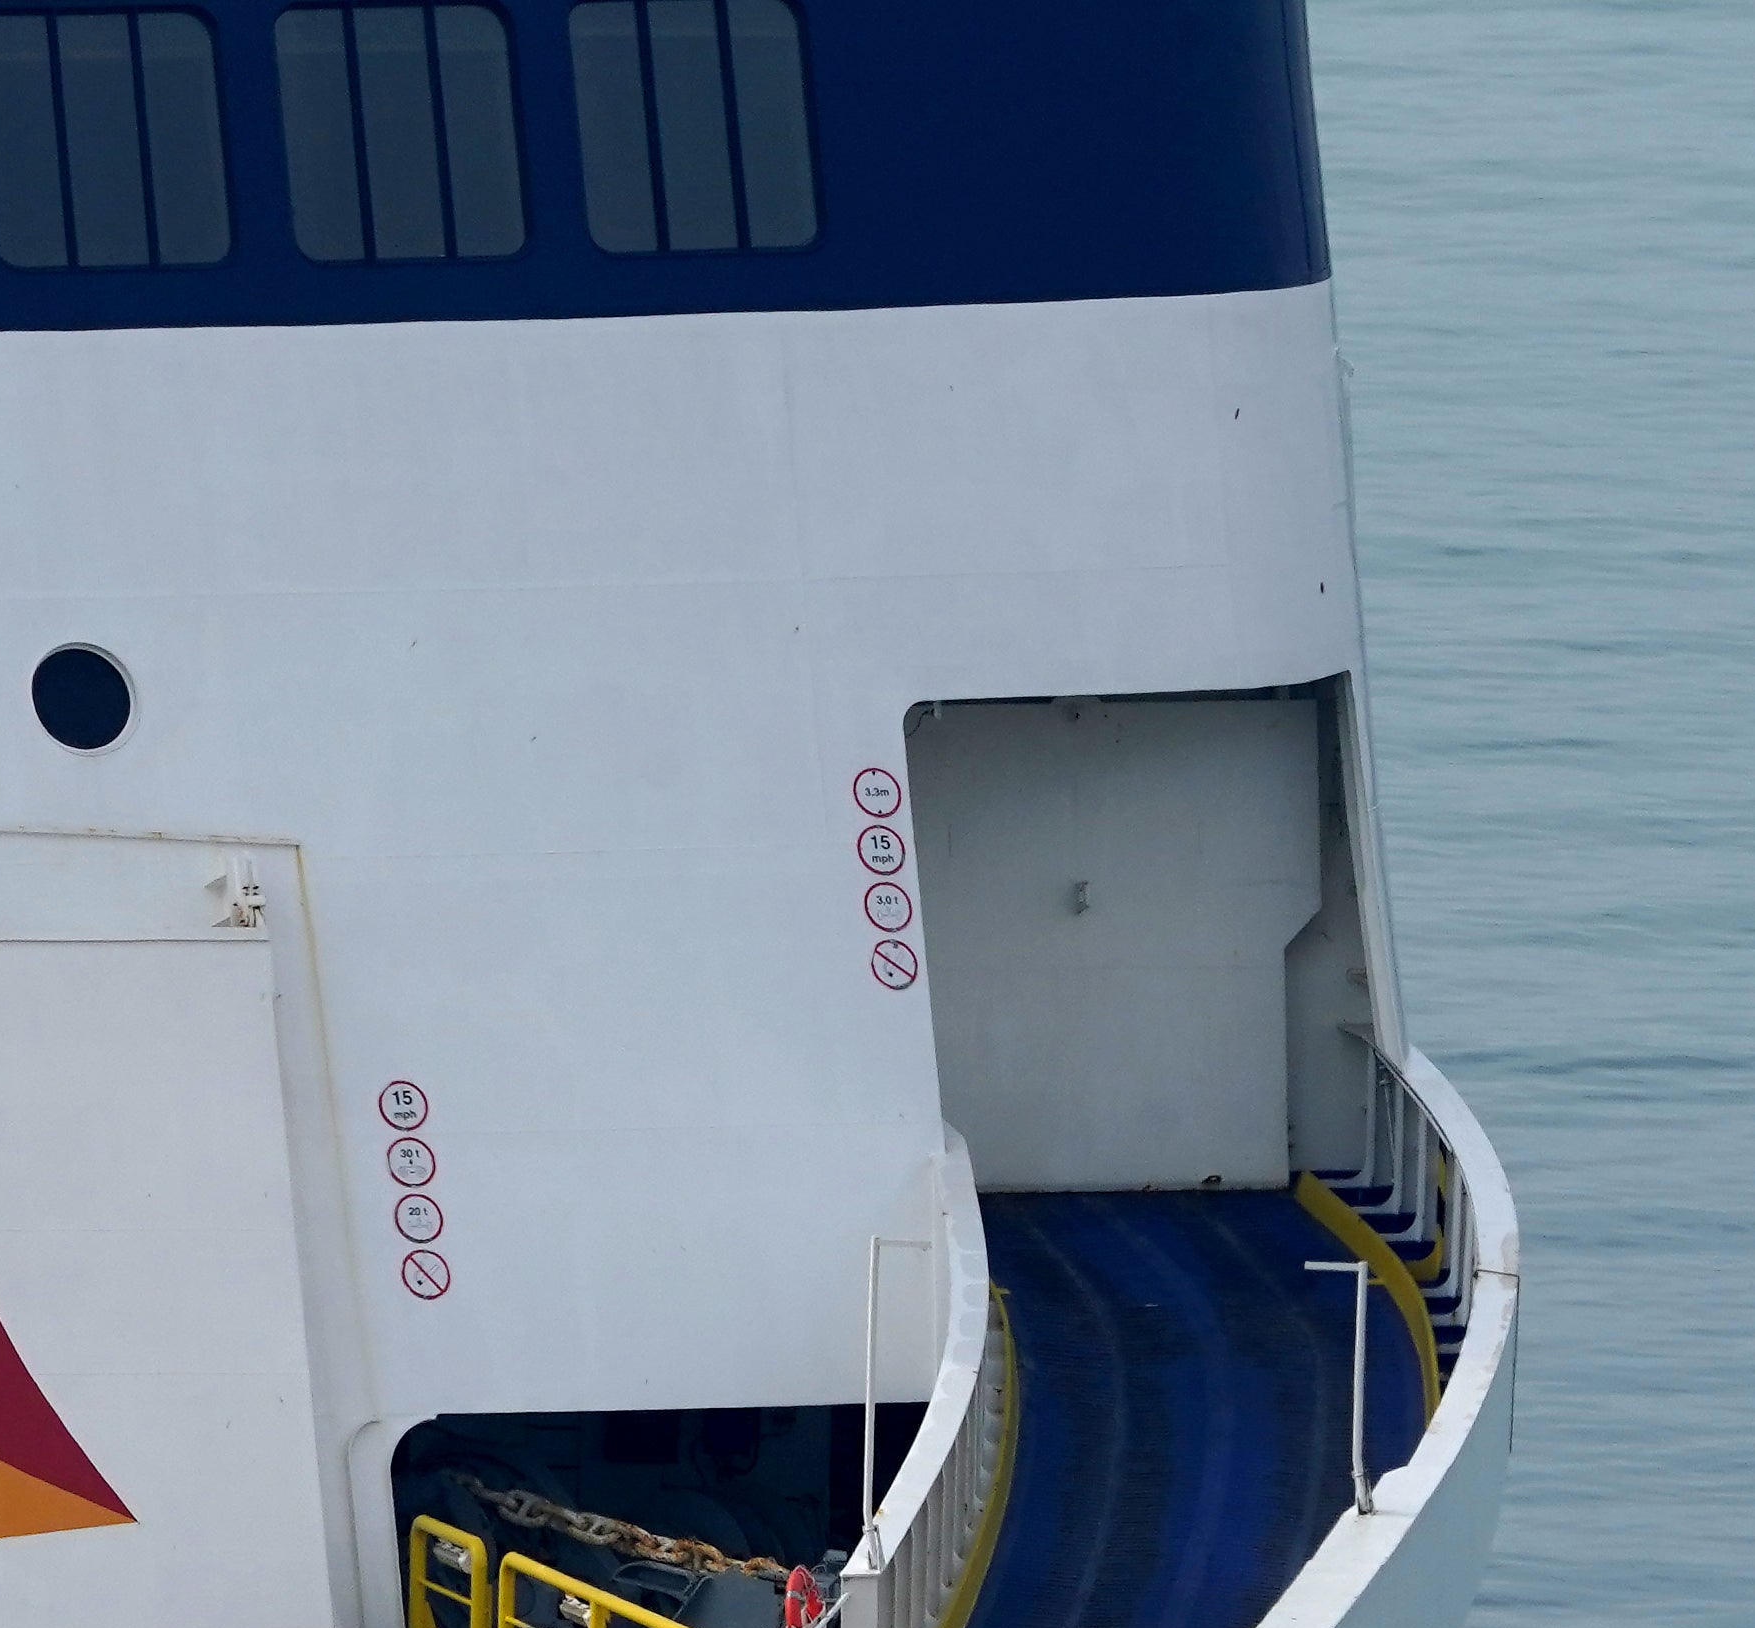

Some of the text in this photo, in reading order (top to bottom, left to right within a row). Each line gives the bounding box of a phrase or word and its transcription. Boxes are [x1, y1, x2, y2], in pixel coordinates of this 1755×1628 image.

[870, 835, 891, 850] 15
[871, 854, 894, 864] mph
[392, 1090, 413, 1106] 15
[394, 1110, 418, 1120] mph
